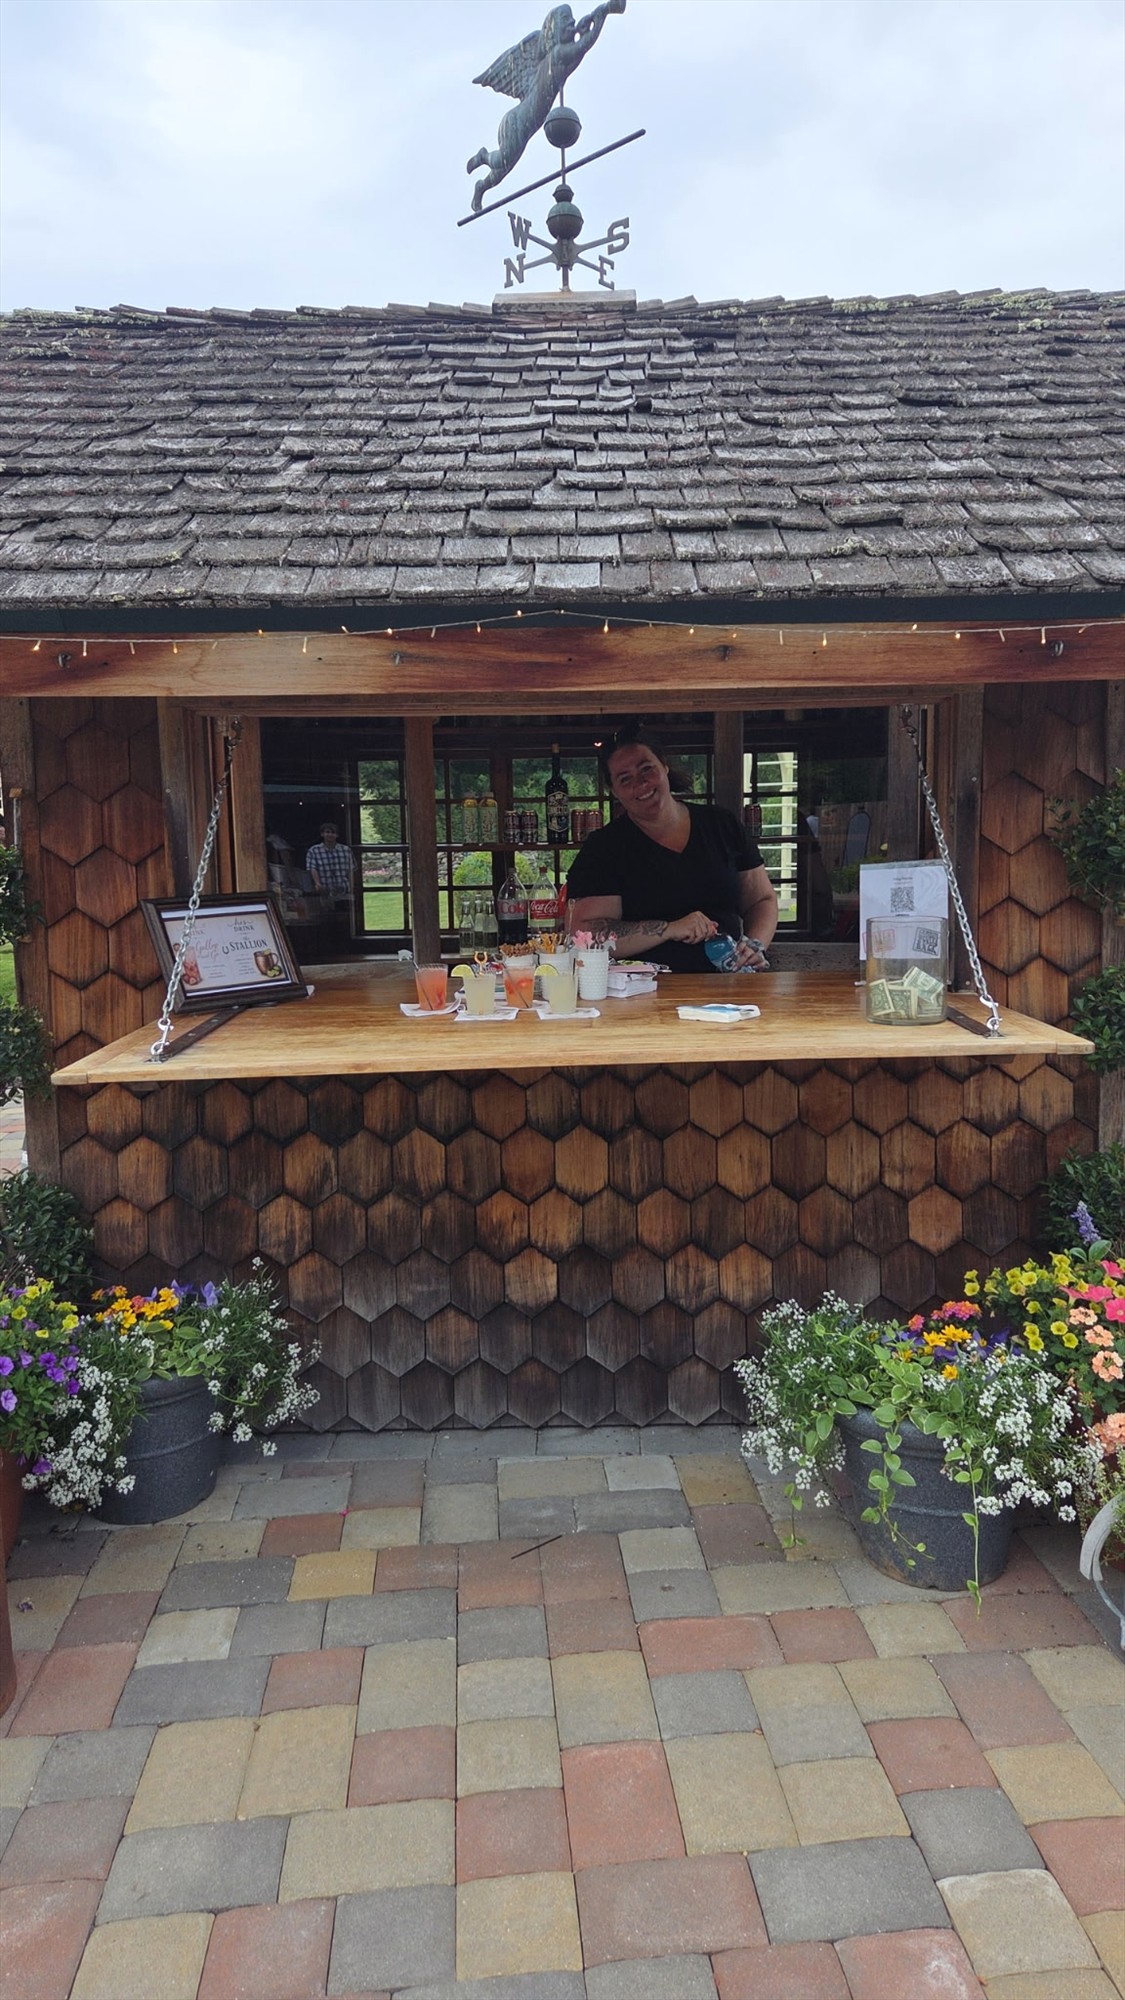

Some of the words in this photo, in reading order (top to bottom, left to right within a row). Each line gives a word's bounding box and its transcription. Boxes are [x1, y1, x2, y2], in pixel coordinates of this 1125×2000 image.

[507, 210, 532, 251] W
[607, 216, 630, 256] S
[503, 252, 526, 289] N
[598, 254, 615, 291] E
[500, 901, 526, 914] Cok
[229, 938, 268, 951] STALLION
